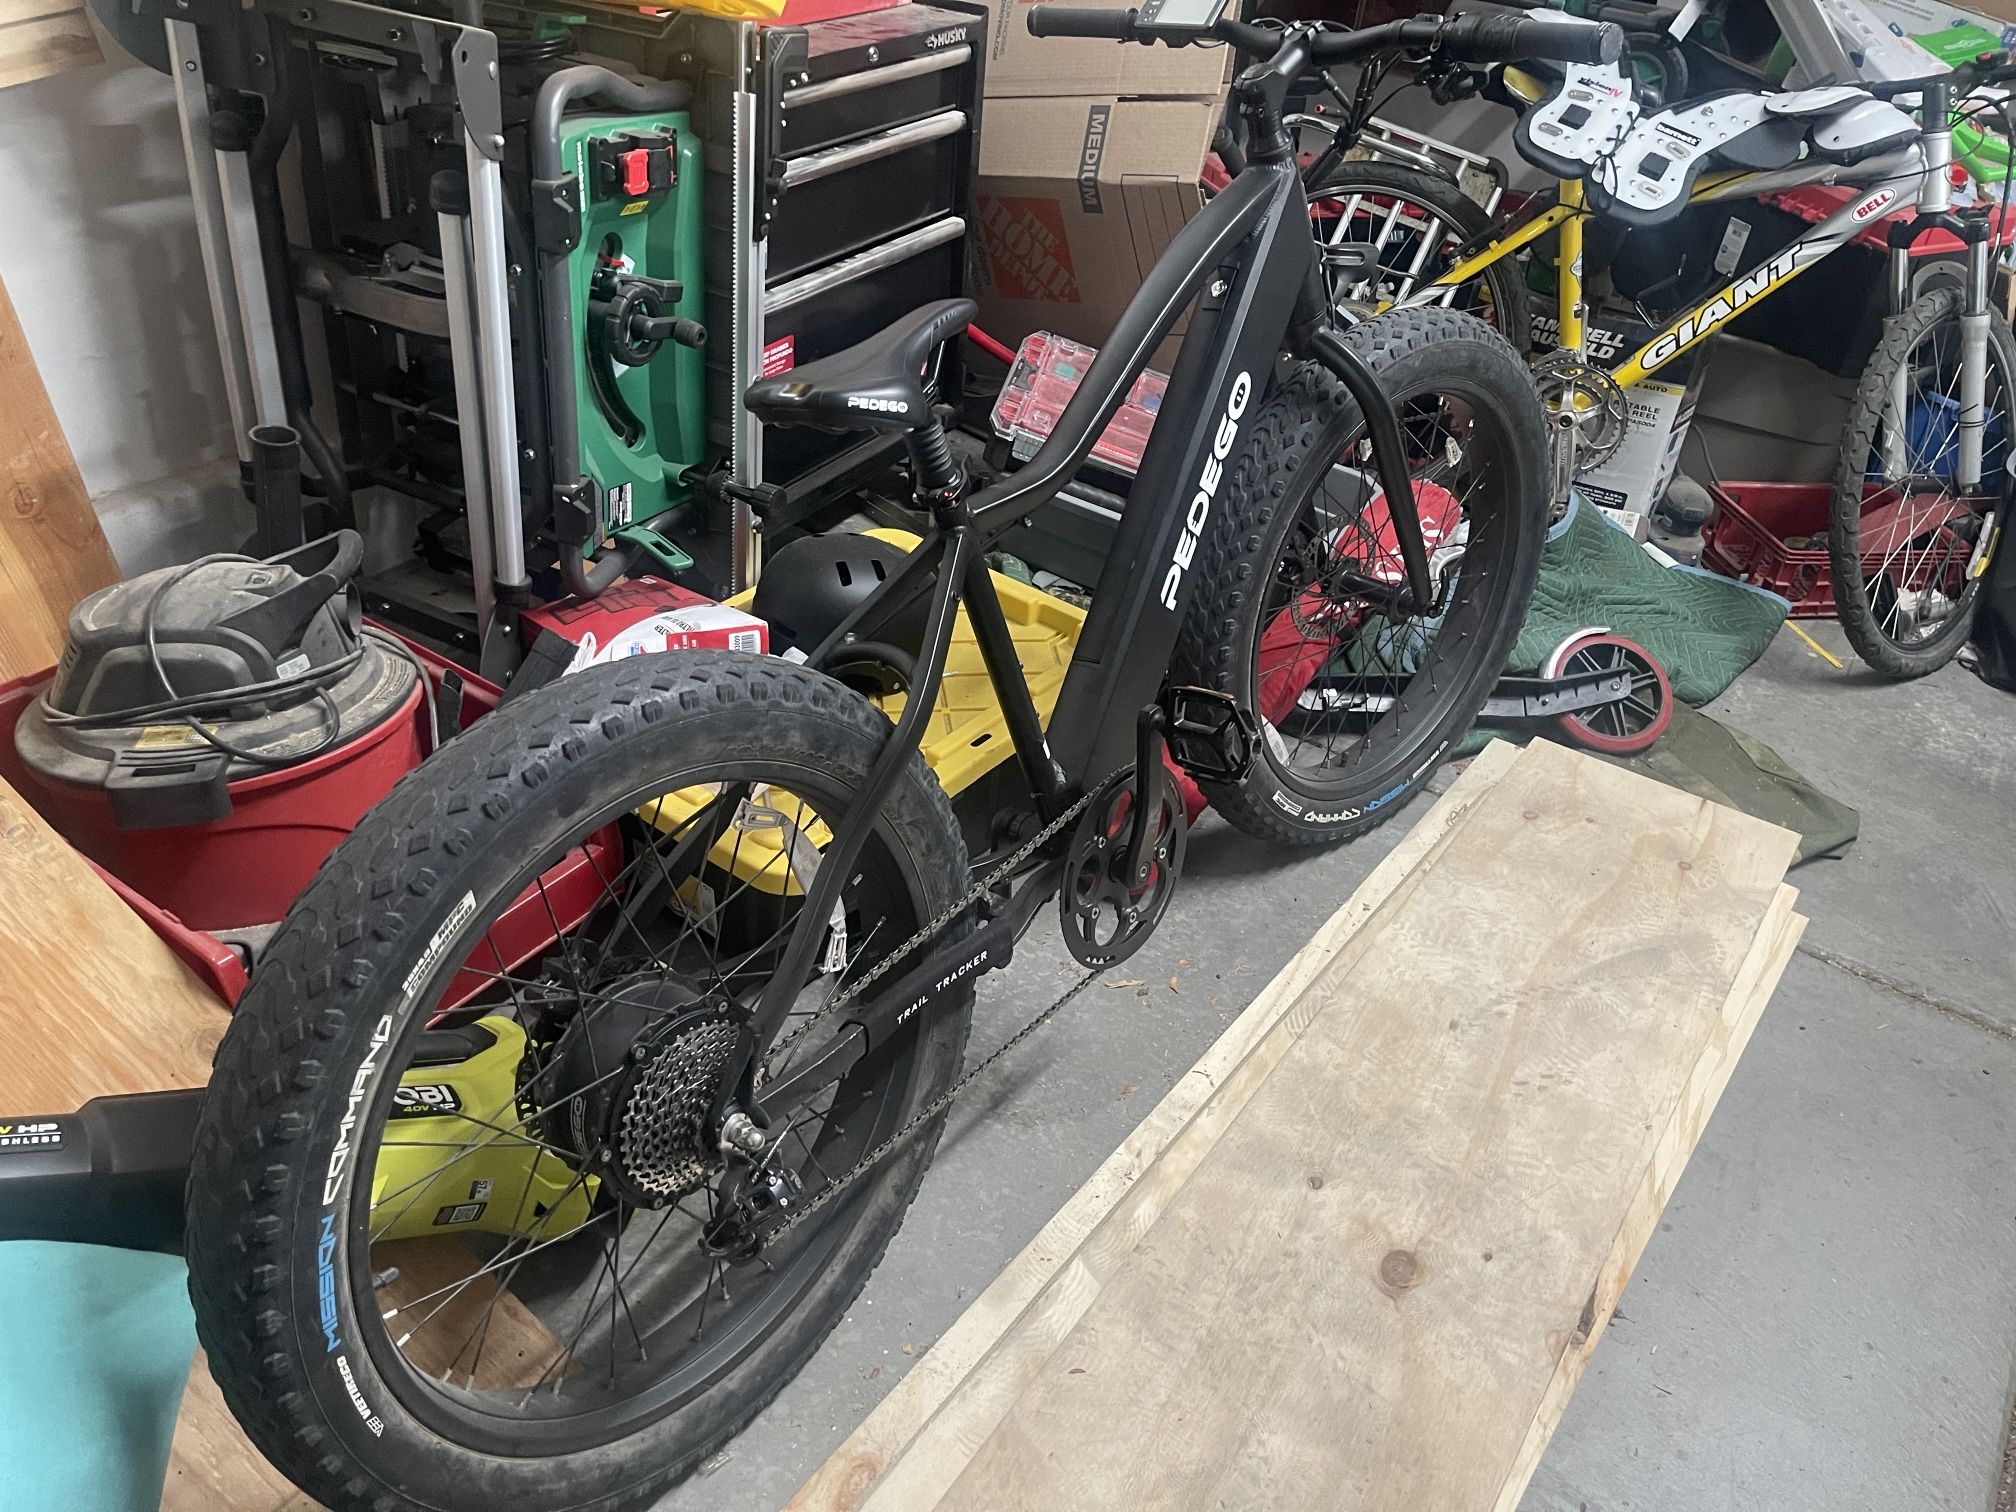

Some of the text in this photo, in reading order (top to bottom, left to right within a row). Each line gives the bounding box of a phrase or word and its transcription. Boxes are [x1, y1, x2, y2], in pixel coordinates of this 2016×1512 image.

[937, 27, 967, 47] HUSKY
[1079, 113, 1105, 205] MEDIUM
[1856, 194, 1892, 219] BELL
[1020, 211, 1059, 252] THE
[980, 198, 1077, 299] HOME
[1641, 244, 1803, 370] GIANT
[1643, 383, 1668, 393] AUTO
[847, 396, 909, 414] PEDEGO
[1631, 410, 1658, 421] REEL
[1160, 371, 1252, 612] PEDEGO
[1304, 808, 1361, 823] COMMAND
[437, 901, 465, 940] MPC
[411, 903, 473, 992] COMPOUND
[896, 950, 988, 1025] TRAIL TRACKER
[322, 1014, 393, 1206] COMMAND
[394, 1085, 454, 1106] OBI
[403, 1104, 429, 1112] 40V
[0, 1135, 61, 1146] SHLESS
[17, 1123, 58, 1134] HP
[318, 1212, 342, 1352] MISSION
